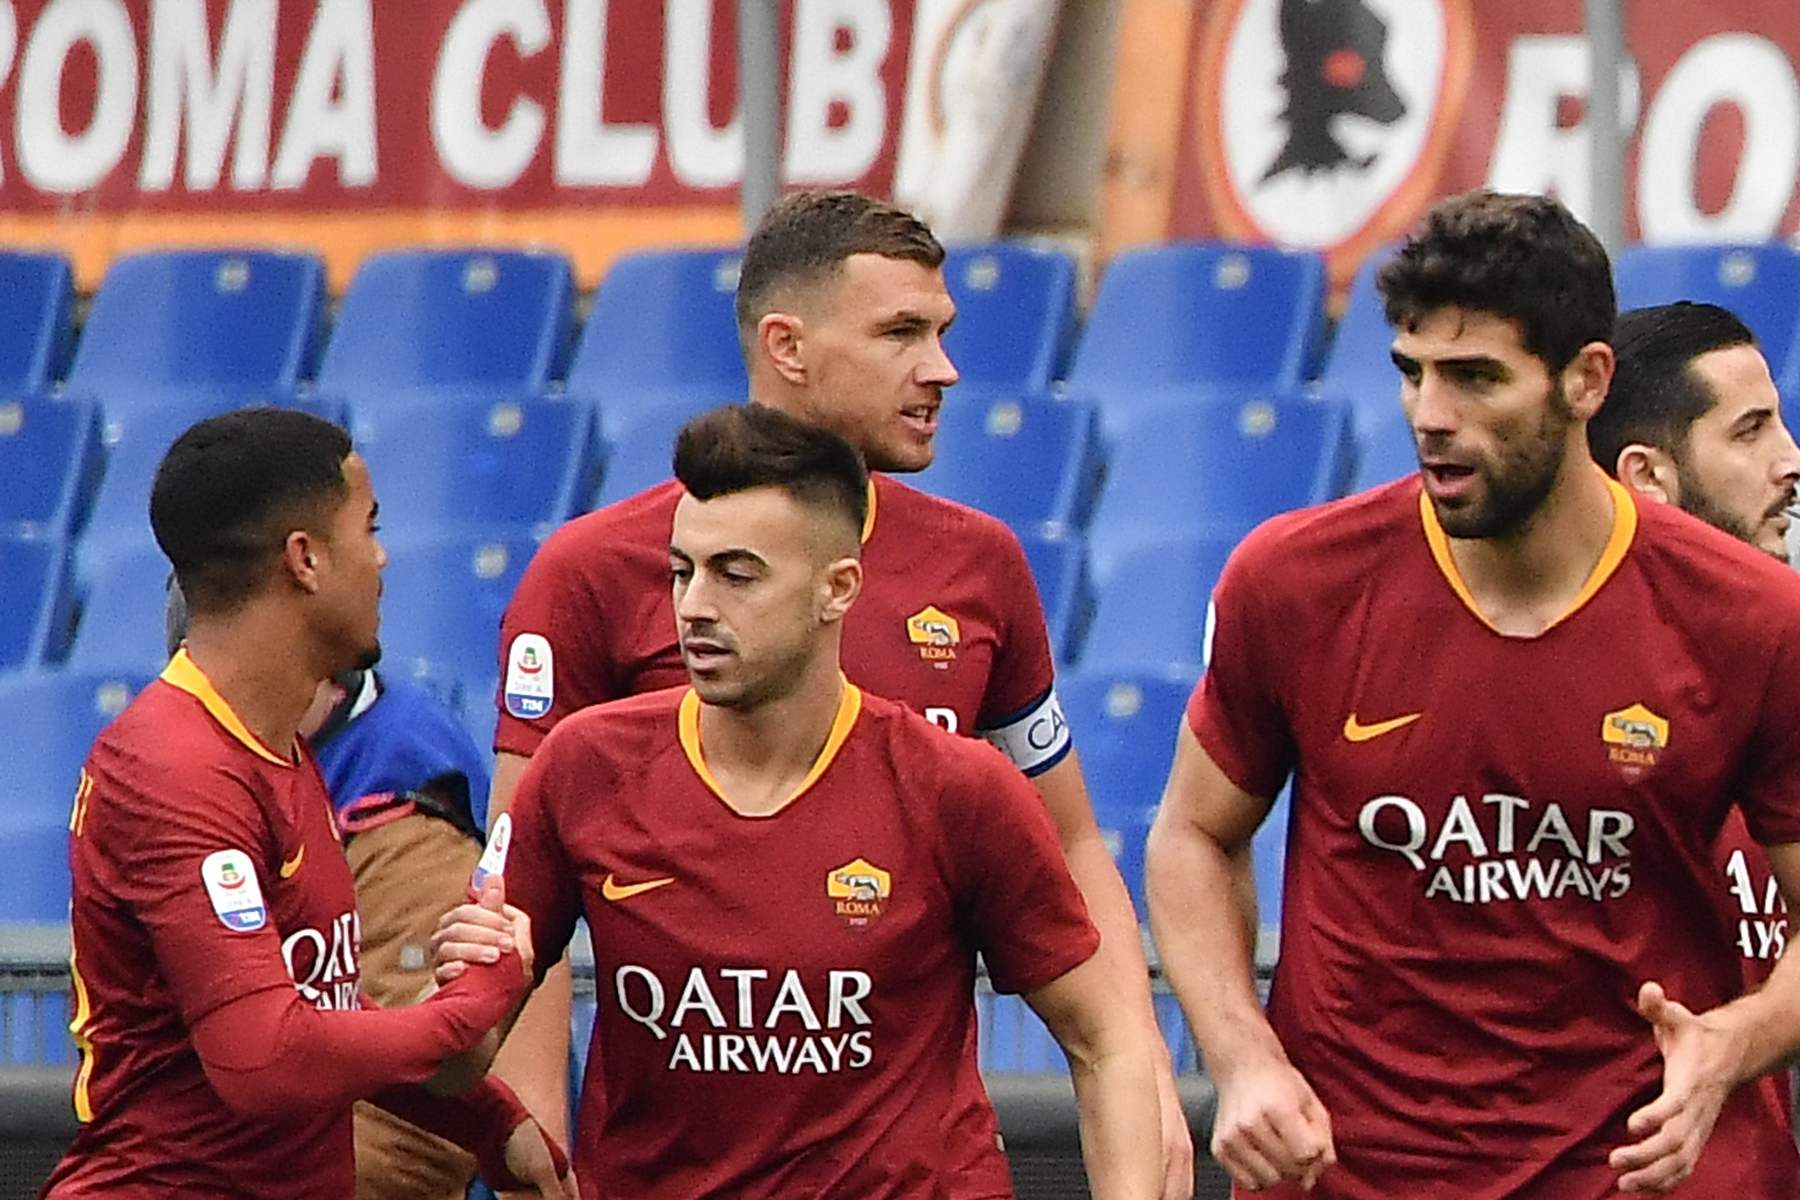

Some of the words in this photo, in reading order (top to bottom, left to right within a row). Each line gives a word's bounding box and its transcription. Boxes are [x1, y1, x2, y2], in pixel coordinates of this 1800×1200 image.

[0, 0, 380, 193] OMA
[430, 0, 895, 189] CLUB
[1357, 793, 1636, 871] QATAR
[1425, 857, 1632, 902] AIRWAYS
[615, 963, 873, 1041] QATAR
[669, 1031, 873, 1074] AIRWAYS
